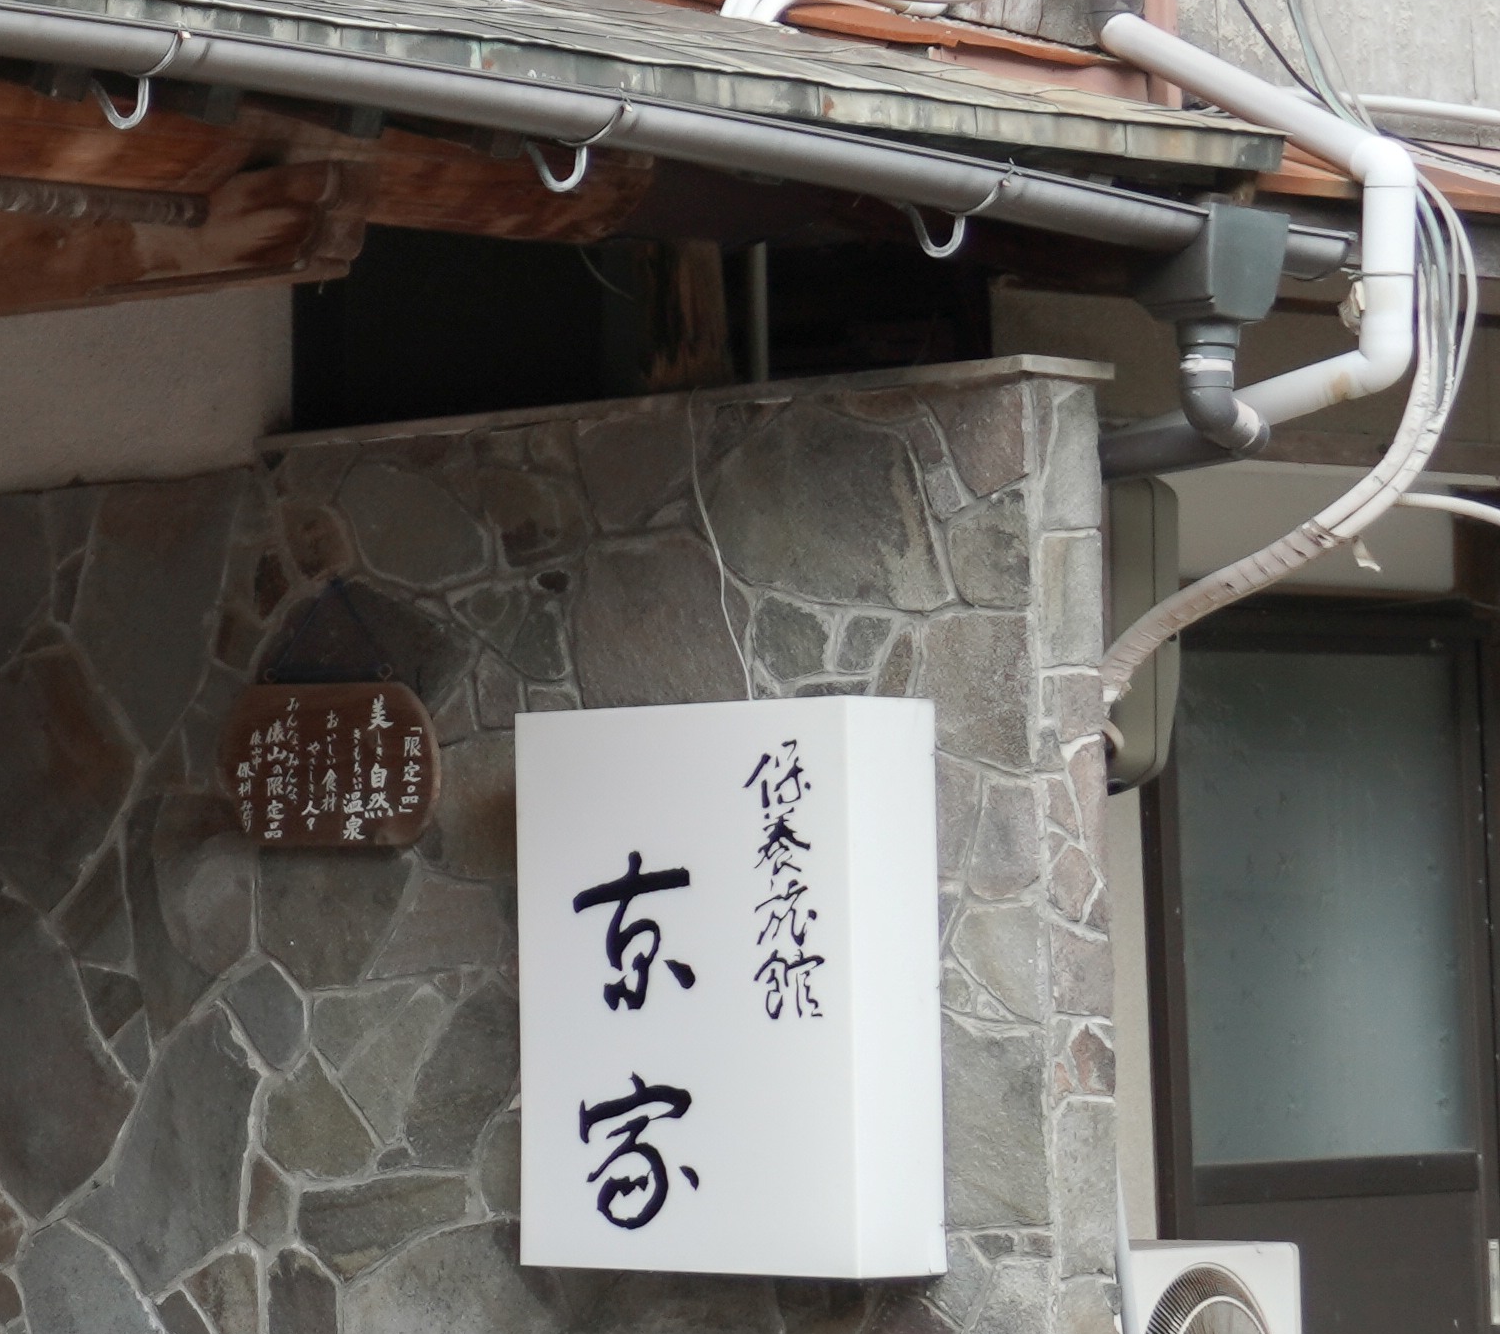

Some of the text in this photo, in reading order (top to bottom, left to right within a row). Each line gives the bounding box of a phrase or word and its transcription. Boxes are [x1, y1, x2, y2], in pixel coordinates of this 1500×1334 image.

[264, 719, 287, 839] 俵山の限定品
[320, 709, 339, 812] おいしい食材
[364, 694, 394, 819] 美しき自然
[398, 726, 423, 814] 「限定品」
[744, 737, 825, 1021] 保養旅館
[572, 849, 701, 1231] 京家
